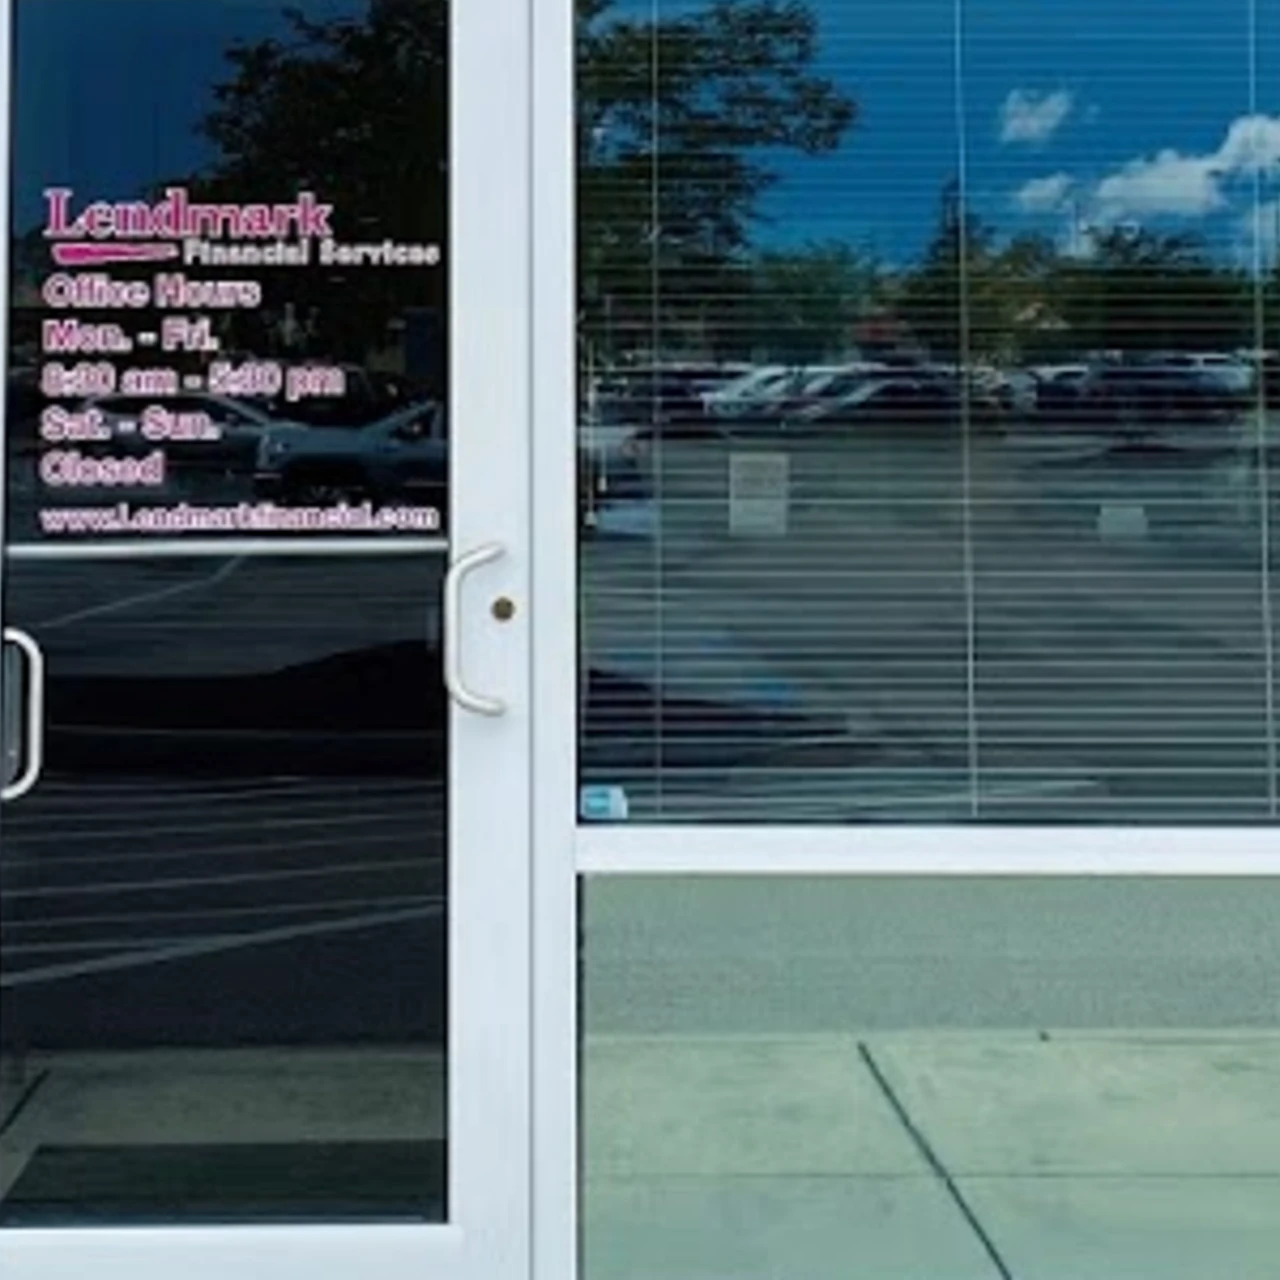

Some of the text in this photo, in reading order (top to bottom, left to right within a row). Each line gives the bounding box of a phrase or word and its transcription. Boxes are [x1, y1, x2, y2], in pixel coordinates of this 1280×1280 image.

[42, 187, 333, 238] Lendmark
[184, 240, 441, 265] Financial Services
[43, 273, 262, 308] Office Hours
[42, 319, 133, 353] Mon.
[162, 317, 219, 351] Fri.
[121, 368, 179, 395] am
[285, 367, 346, 402] pm
[40, 450, 165, 486] Closed
